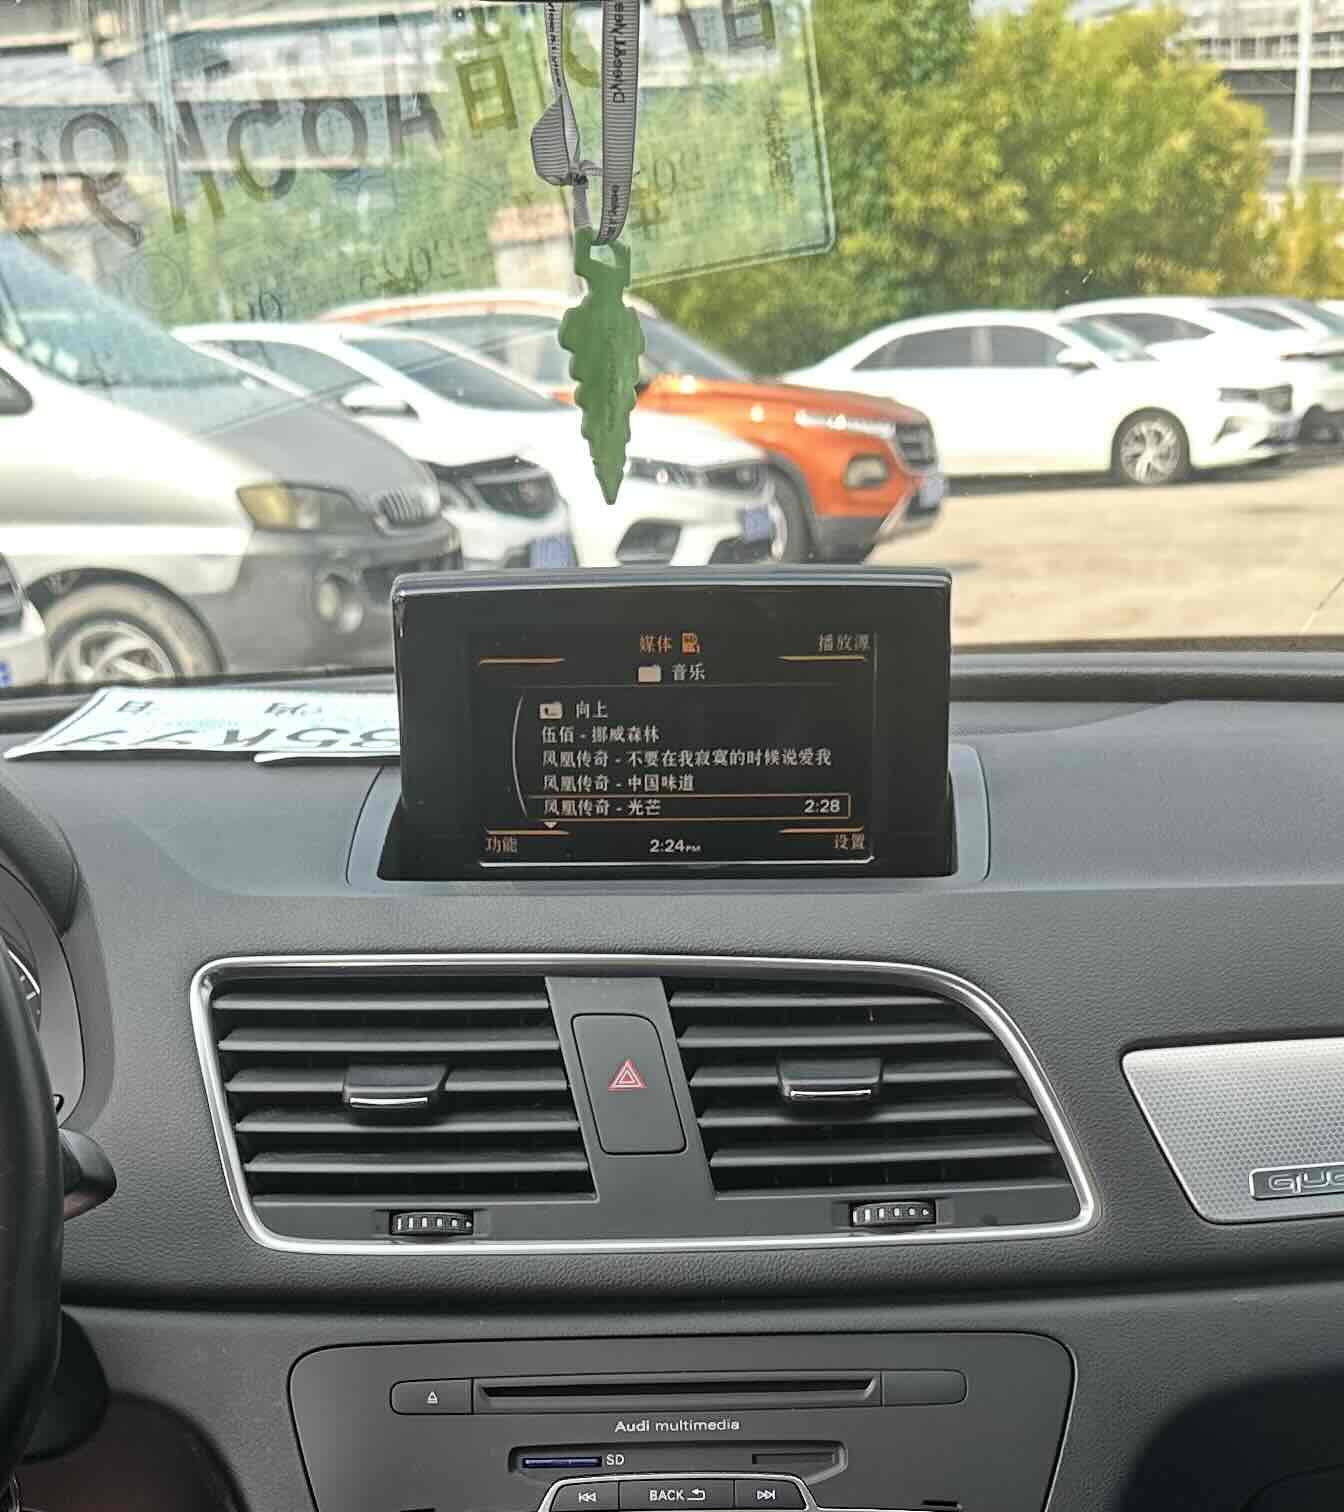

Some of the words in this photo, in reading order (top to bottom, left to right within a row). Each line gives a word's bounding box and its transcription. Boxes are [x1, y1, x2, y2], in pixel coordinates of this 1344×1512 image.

[639, 633, 672, 655] 媒体
[671, 663, 705, 681] 音乐
[575, 700, 609, 719] 向上
[804, 799, 841, 814] 2:28
[485, 836, 518, 854] 功能
[832, 833, 866, 851] 设置
[614, 1419, 650, 1433] Audi
[655, 1417, 740, 1433] multimedia
[606, 1453, 625, 1466] SD
[649, 1489, 686, 1502] BACK
